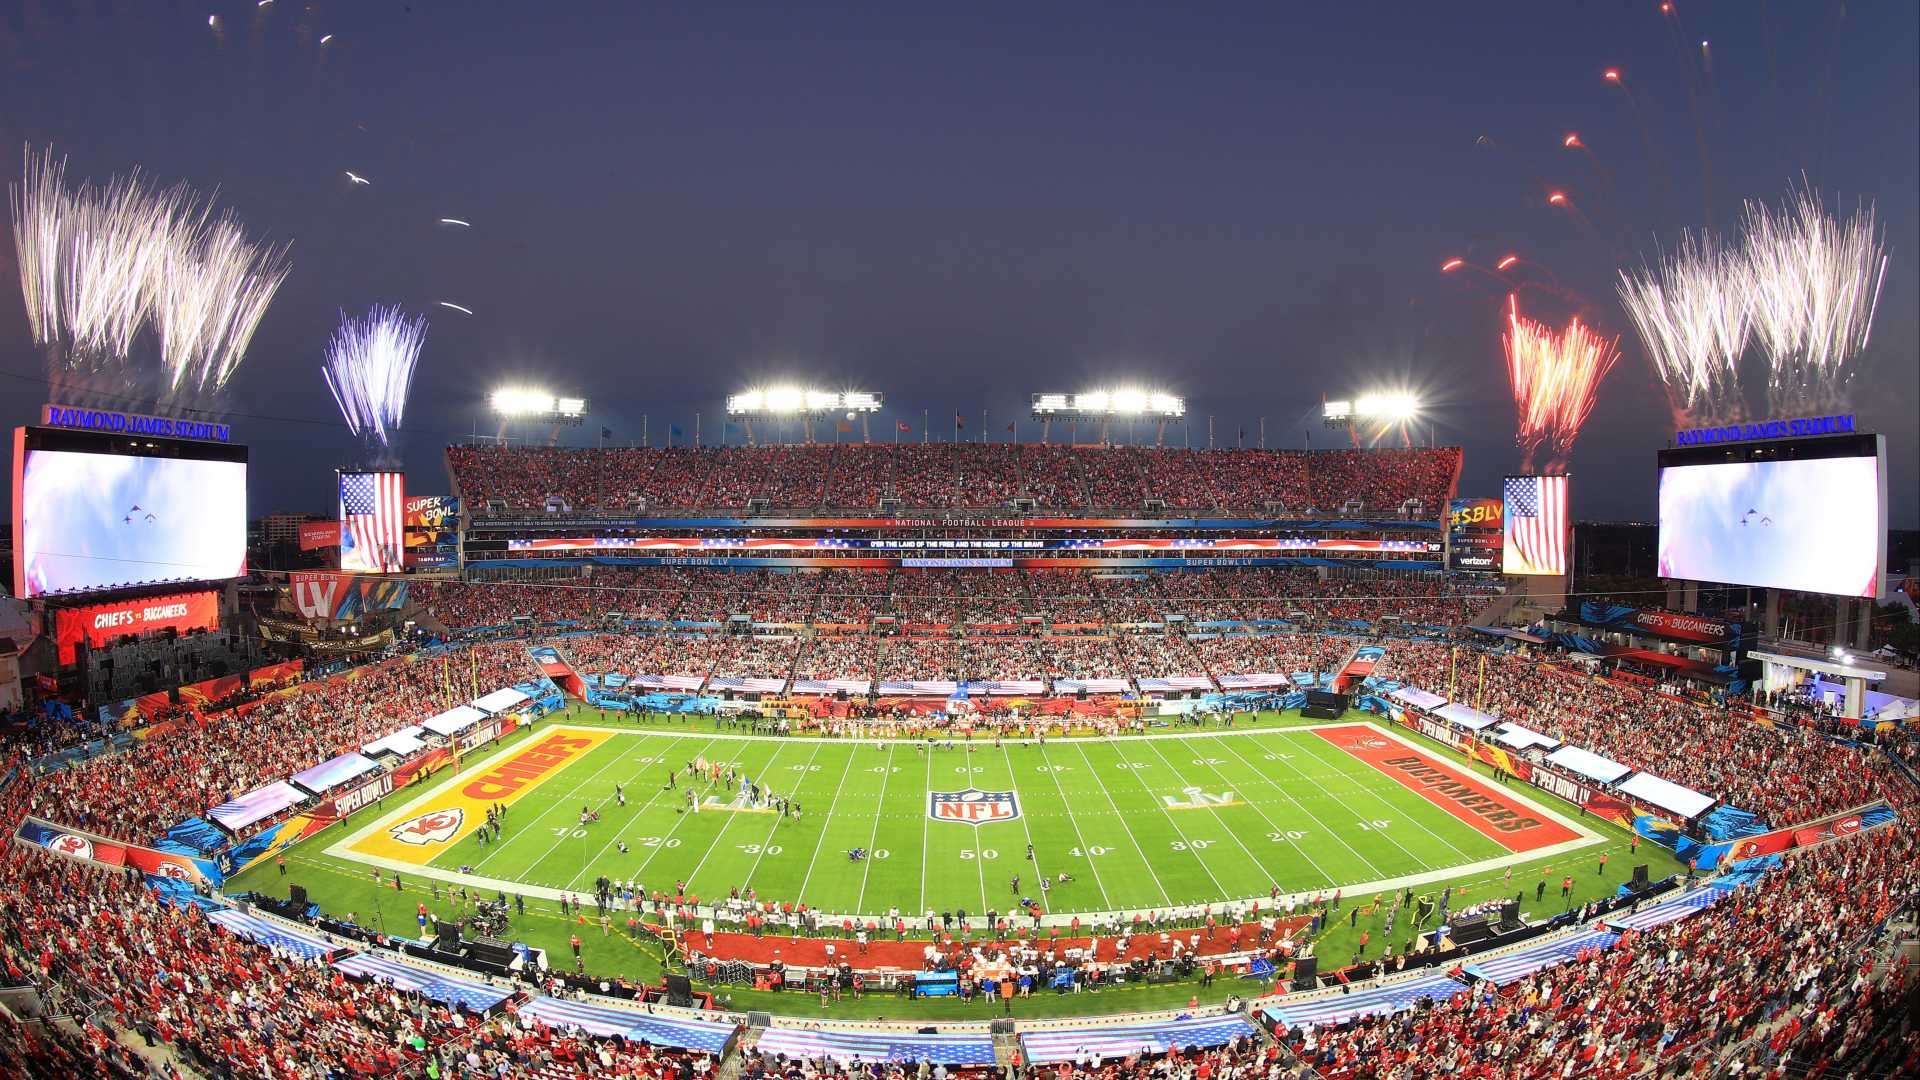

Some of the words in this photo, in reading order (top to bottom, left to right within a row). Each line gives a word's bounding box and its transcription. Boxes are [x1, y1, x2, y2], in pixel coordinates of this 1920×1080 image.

[48, 406, 126, 430] RAYMOND
[126, 415, 172, 435] JAMES
[174, 420, 230, 442] STADIUM
[1677, 426, 1739, 444] RAYMOND
[1743, 419, 1788, 441] JAMES
[1789, 414, 1855, 438] STADIUM
[406, 497, 441, 513] SUPER
[426, 505, 455, 521] BOWL
[1452, 503, 1503, 525] #SBLV
[895, 519, 937, 527] NATIONAL
[942, 519, 986, 527] FOOTBALL
[992, 519, 1025, 527] LEAGUE
[1460, 556, 1490, 566] verizon
[296, 574, 318, 582] SUPER
[320, 573, 339, 581] BOWL
[94, 610, 134, 629] CHIEFS
[143, 603, 188, 622] BUCCANEERS
[1637, 613, 1664, 626] CHIEFS
[1671, 618, 1725, 636] BUCCANEERS
[462, 734, 594, 800] CHIEFS
[334, 792, 361, 818] SUPER
[361, 779, 385, 805] BOWL
[383, 774, 393, 794] LV
[1379, 756, 1543, 834] BUCCANEERS
[1556, 777, 1579, 803] BOWL
[1579, 788, 1591, 805] LV
[939, 802, 1011, 819] NFL
[405, 814, 457, 835] KC
[1358, 819, 1389, 831] 10
[555, 827, 588, 839] 10
[1266, 830, 1303, 842] 20
[645, 837, 682, 848] 20
[743, 844, 783, 855] 30
[1170, 839, 1208, 851] 30
[959, 849, 998, 859] 50
[1068, 846, 1106, 857] 40
